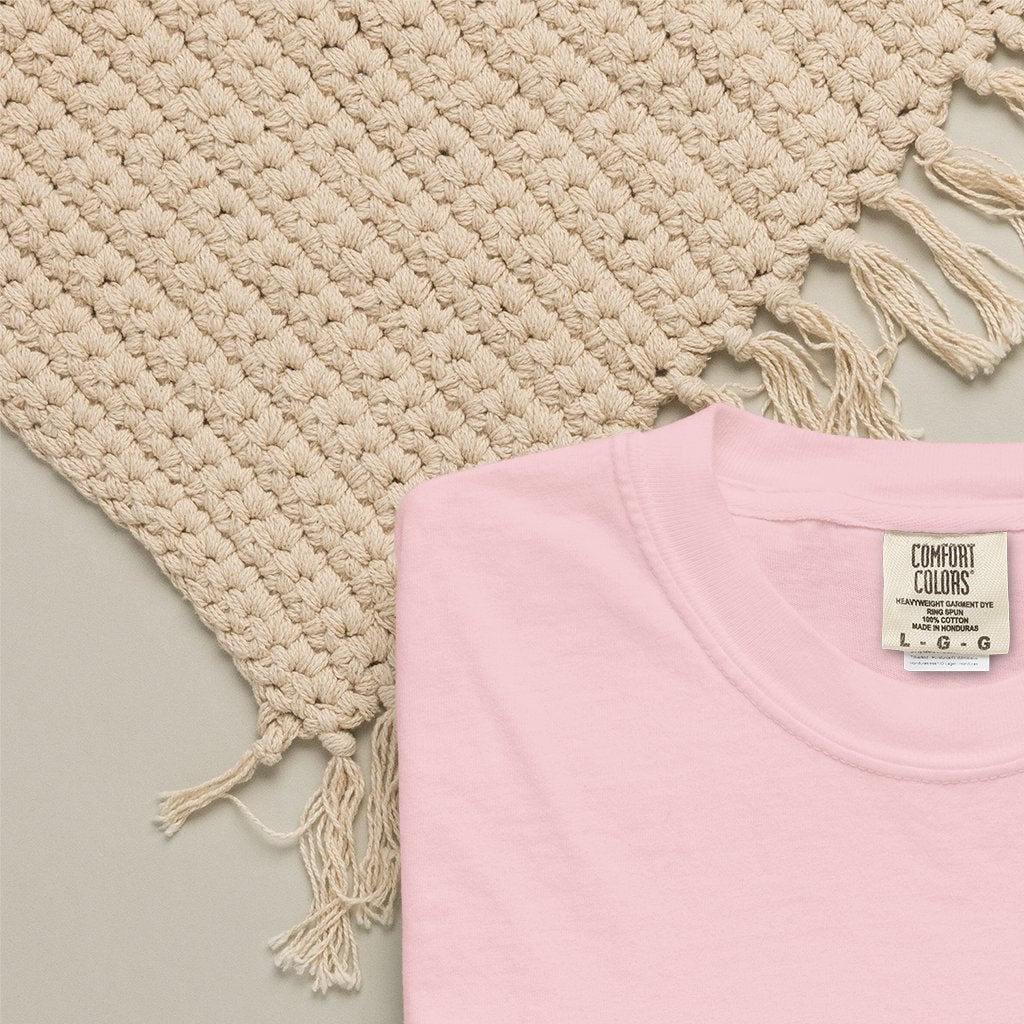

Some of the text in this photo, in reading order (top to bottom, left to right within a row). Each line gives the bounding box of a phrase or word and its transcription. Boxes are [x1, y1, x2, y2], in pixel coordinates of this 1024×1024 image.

[911, 542, 976, 569] COMFORT
[895, 598, 944, 608] HEAVYWEIGHT
[979, 601, 994, 609] DYE
[926, 608, 964, 616] RING SPUN
[922, 616, 969, 624] 100% COTTON
[911, 622, 932, 631] MADE
[941, 624, 979, 632] HONDURAS
[899, 632, 911, 648] L
[936, 635, 951, 650] G
[977, 635, 991, 651] G
